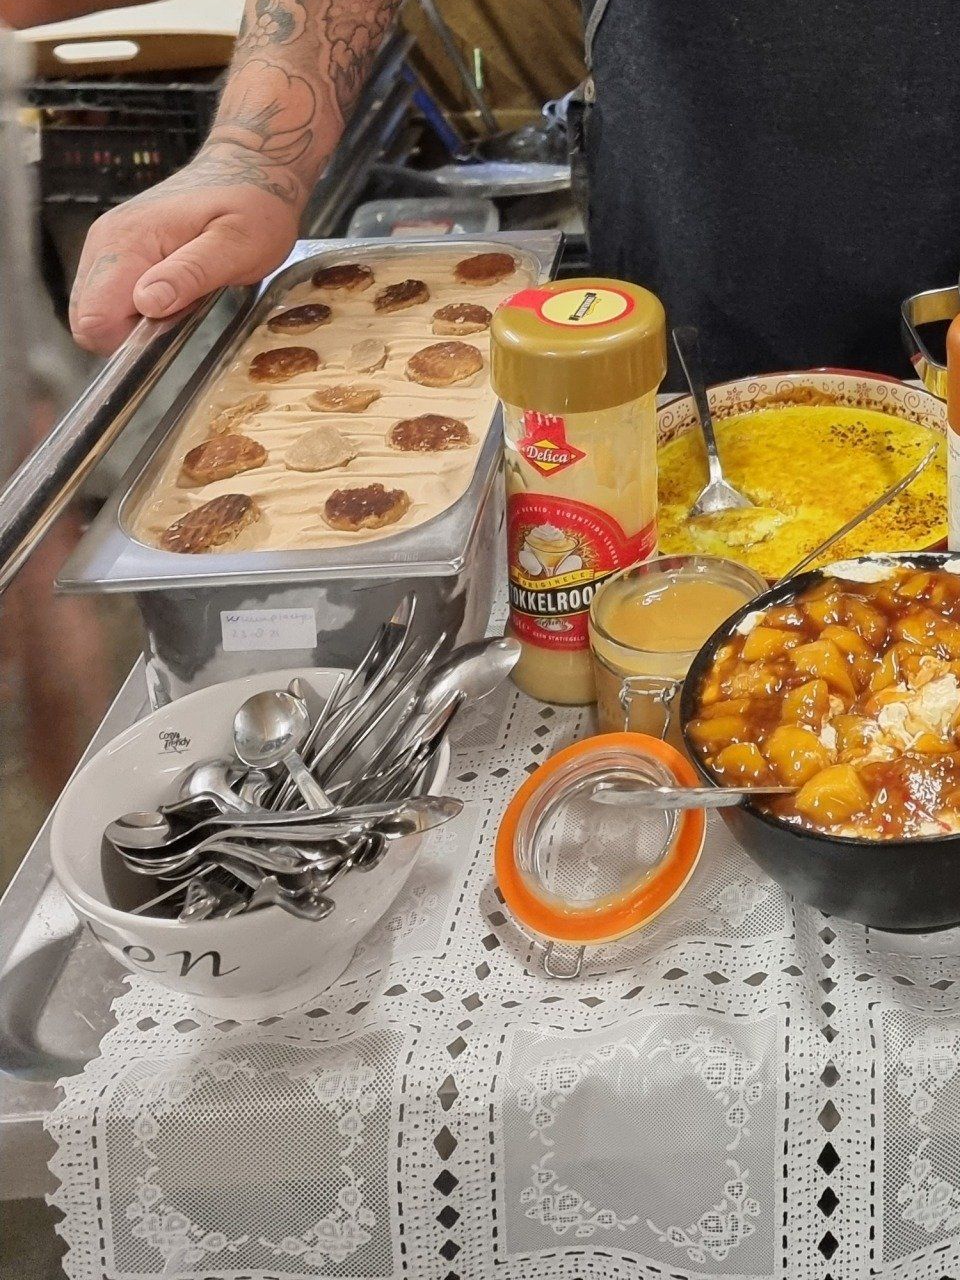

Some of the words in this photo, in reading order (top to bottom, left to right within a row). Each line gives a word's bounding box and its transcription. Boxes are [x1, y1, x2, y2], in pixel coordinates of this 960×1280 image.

[526, 445, 569, 463] Delica
[521, 573, 587, 589] ORIGINELE
[164, 736, 191, 751] Trendy
